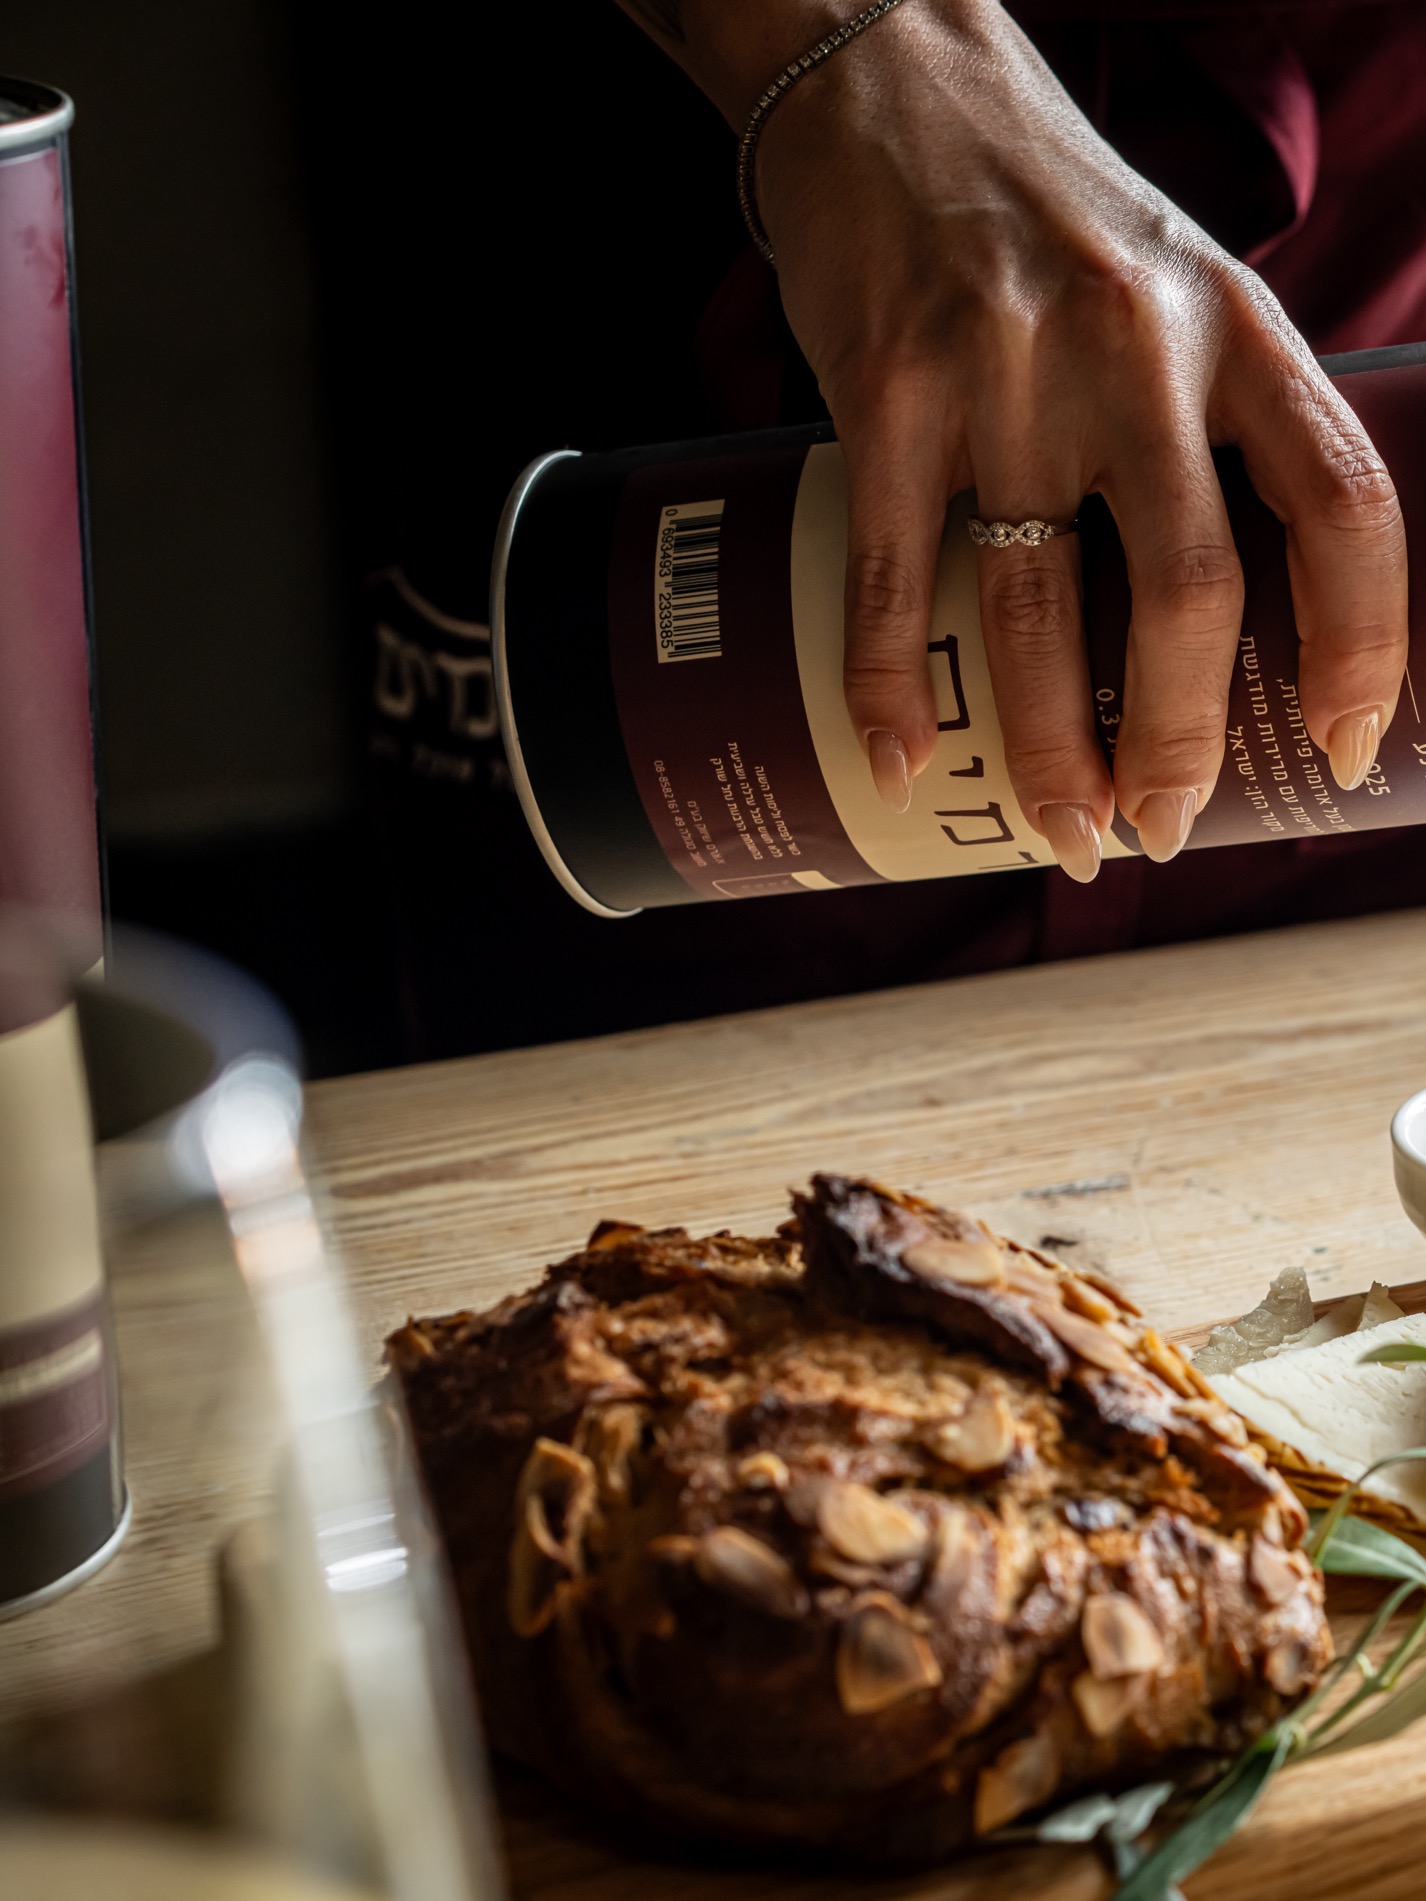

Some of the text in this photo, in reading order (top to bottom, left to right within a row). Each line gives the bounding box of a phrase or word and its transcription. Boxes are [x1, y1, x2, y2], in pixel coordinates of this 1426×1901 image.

[658, 508, 678, 649] 0 693493 233385
[1239, 635, 1269, 716] מודגשת
[1276, 678, 1313, 758] פירותית,
[709, 757, 727, 782] שורק
[728, 741, 747, 780] ושביעית
[1227, 725, 1257, 781] ישראל
[1257, 722, 1289, 782] מרירות
[721, 784, 734, 801] נחל
[740, 782, 756, 806] ערלה
[1279, 785, 1299, 804] עם
[1302, 763, 1333, 806] ארומה
[1365, 763, 1391, 796] 025
[754, 765, 801, 856] כשר לפסח ולימות השנה
[1261, 811, 1285, 832] מקור
[1323, 806, 1345, 826] בעל
[768, 845, 783, 858] ללא
